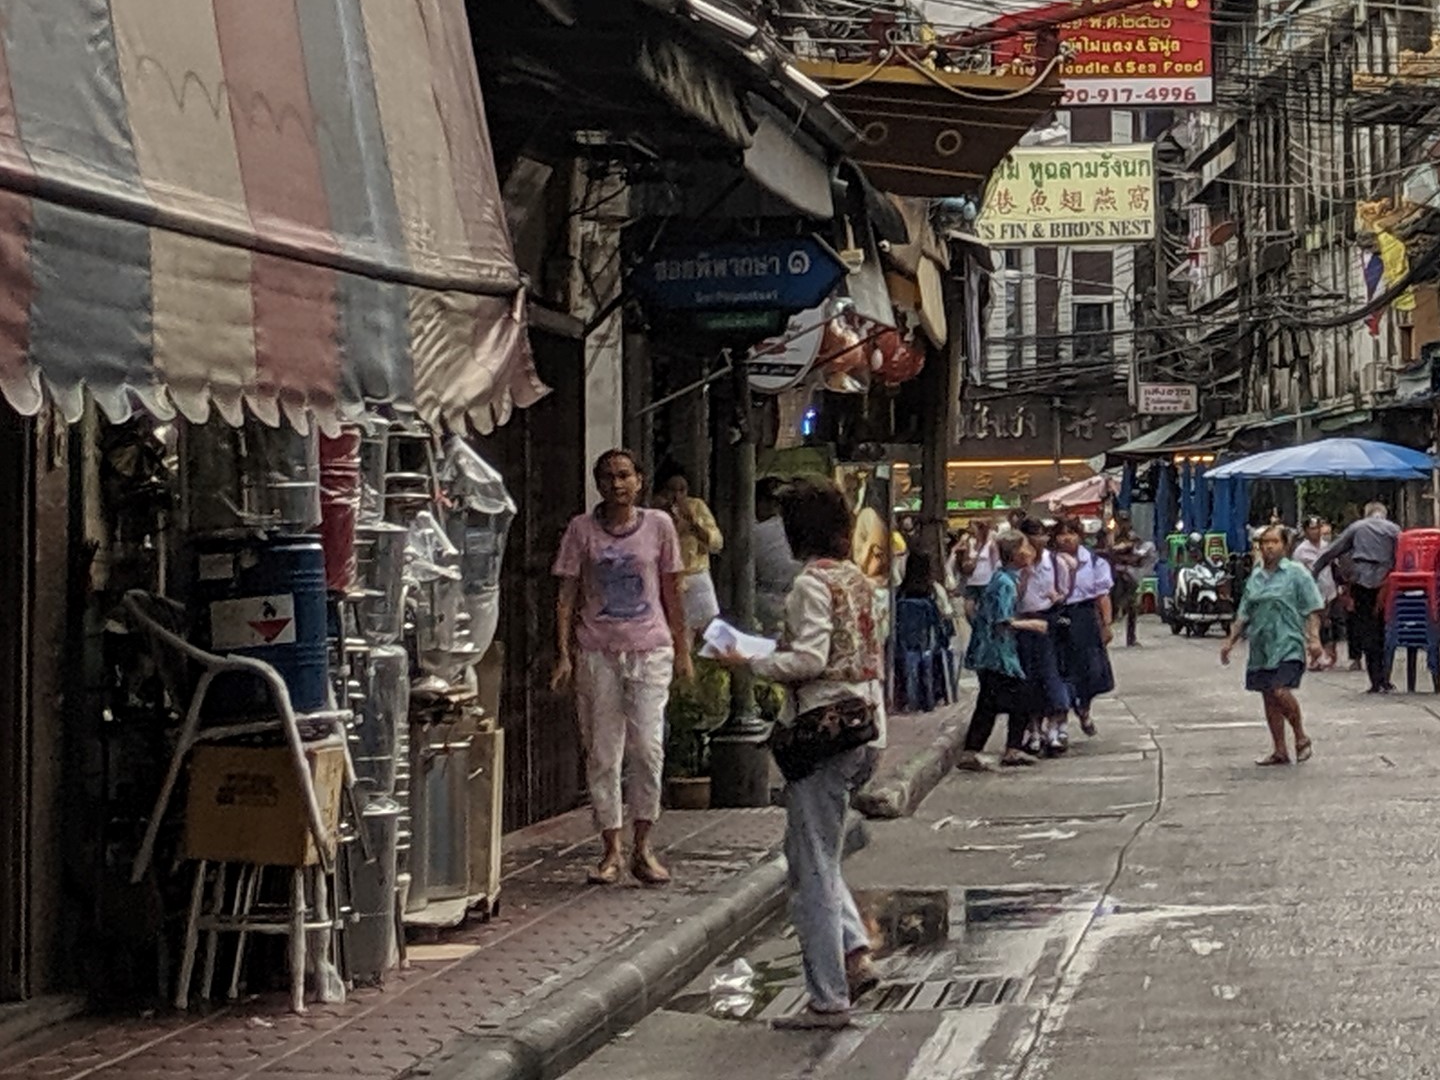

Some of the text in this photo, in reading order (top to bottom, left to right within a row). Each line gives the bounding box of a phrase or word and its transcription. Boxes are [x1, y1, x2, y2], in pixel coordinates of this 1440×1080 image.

[1126, 61, 1157, 74] Sea
[1163, 60, 1204, 74] Food
[1000, 222, 1027, 239] FIN
[1033, 223, 1045, 238] &
[1050, 221, 1104, 238] BIRD'S
[1109, 219, 1151, 236] NEST
